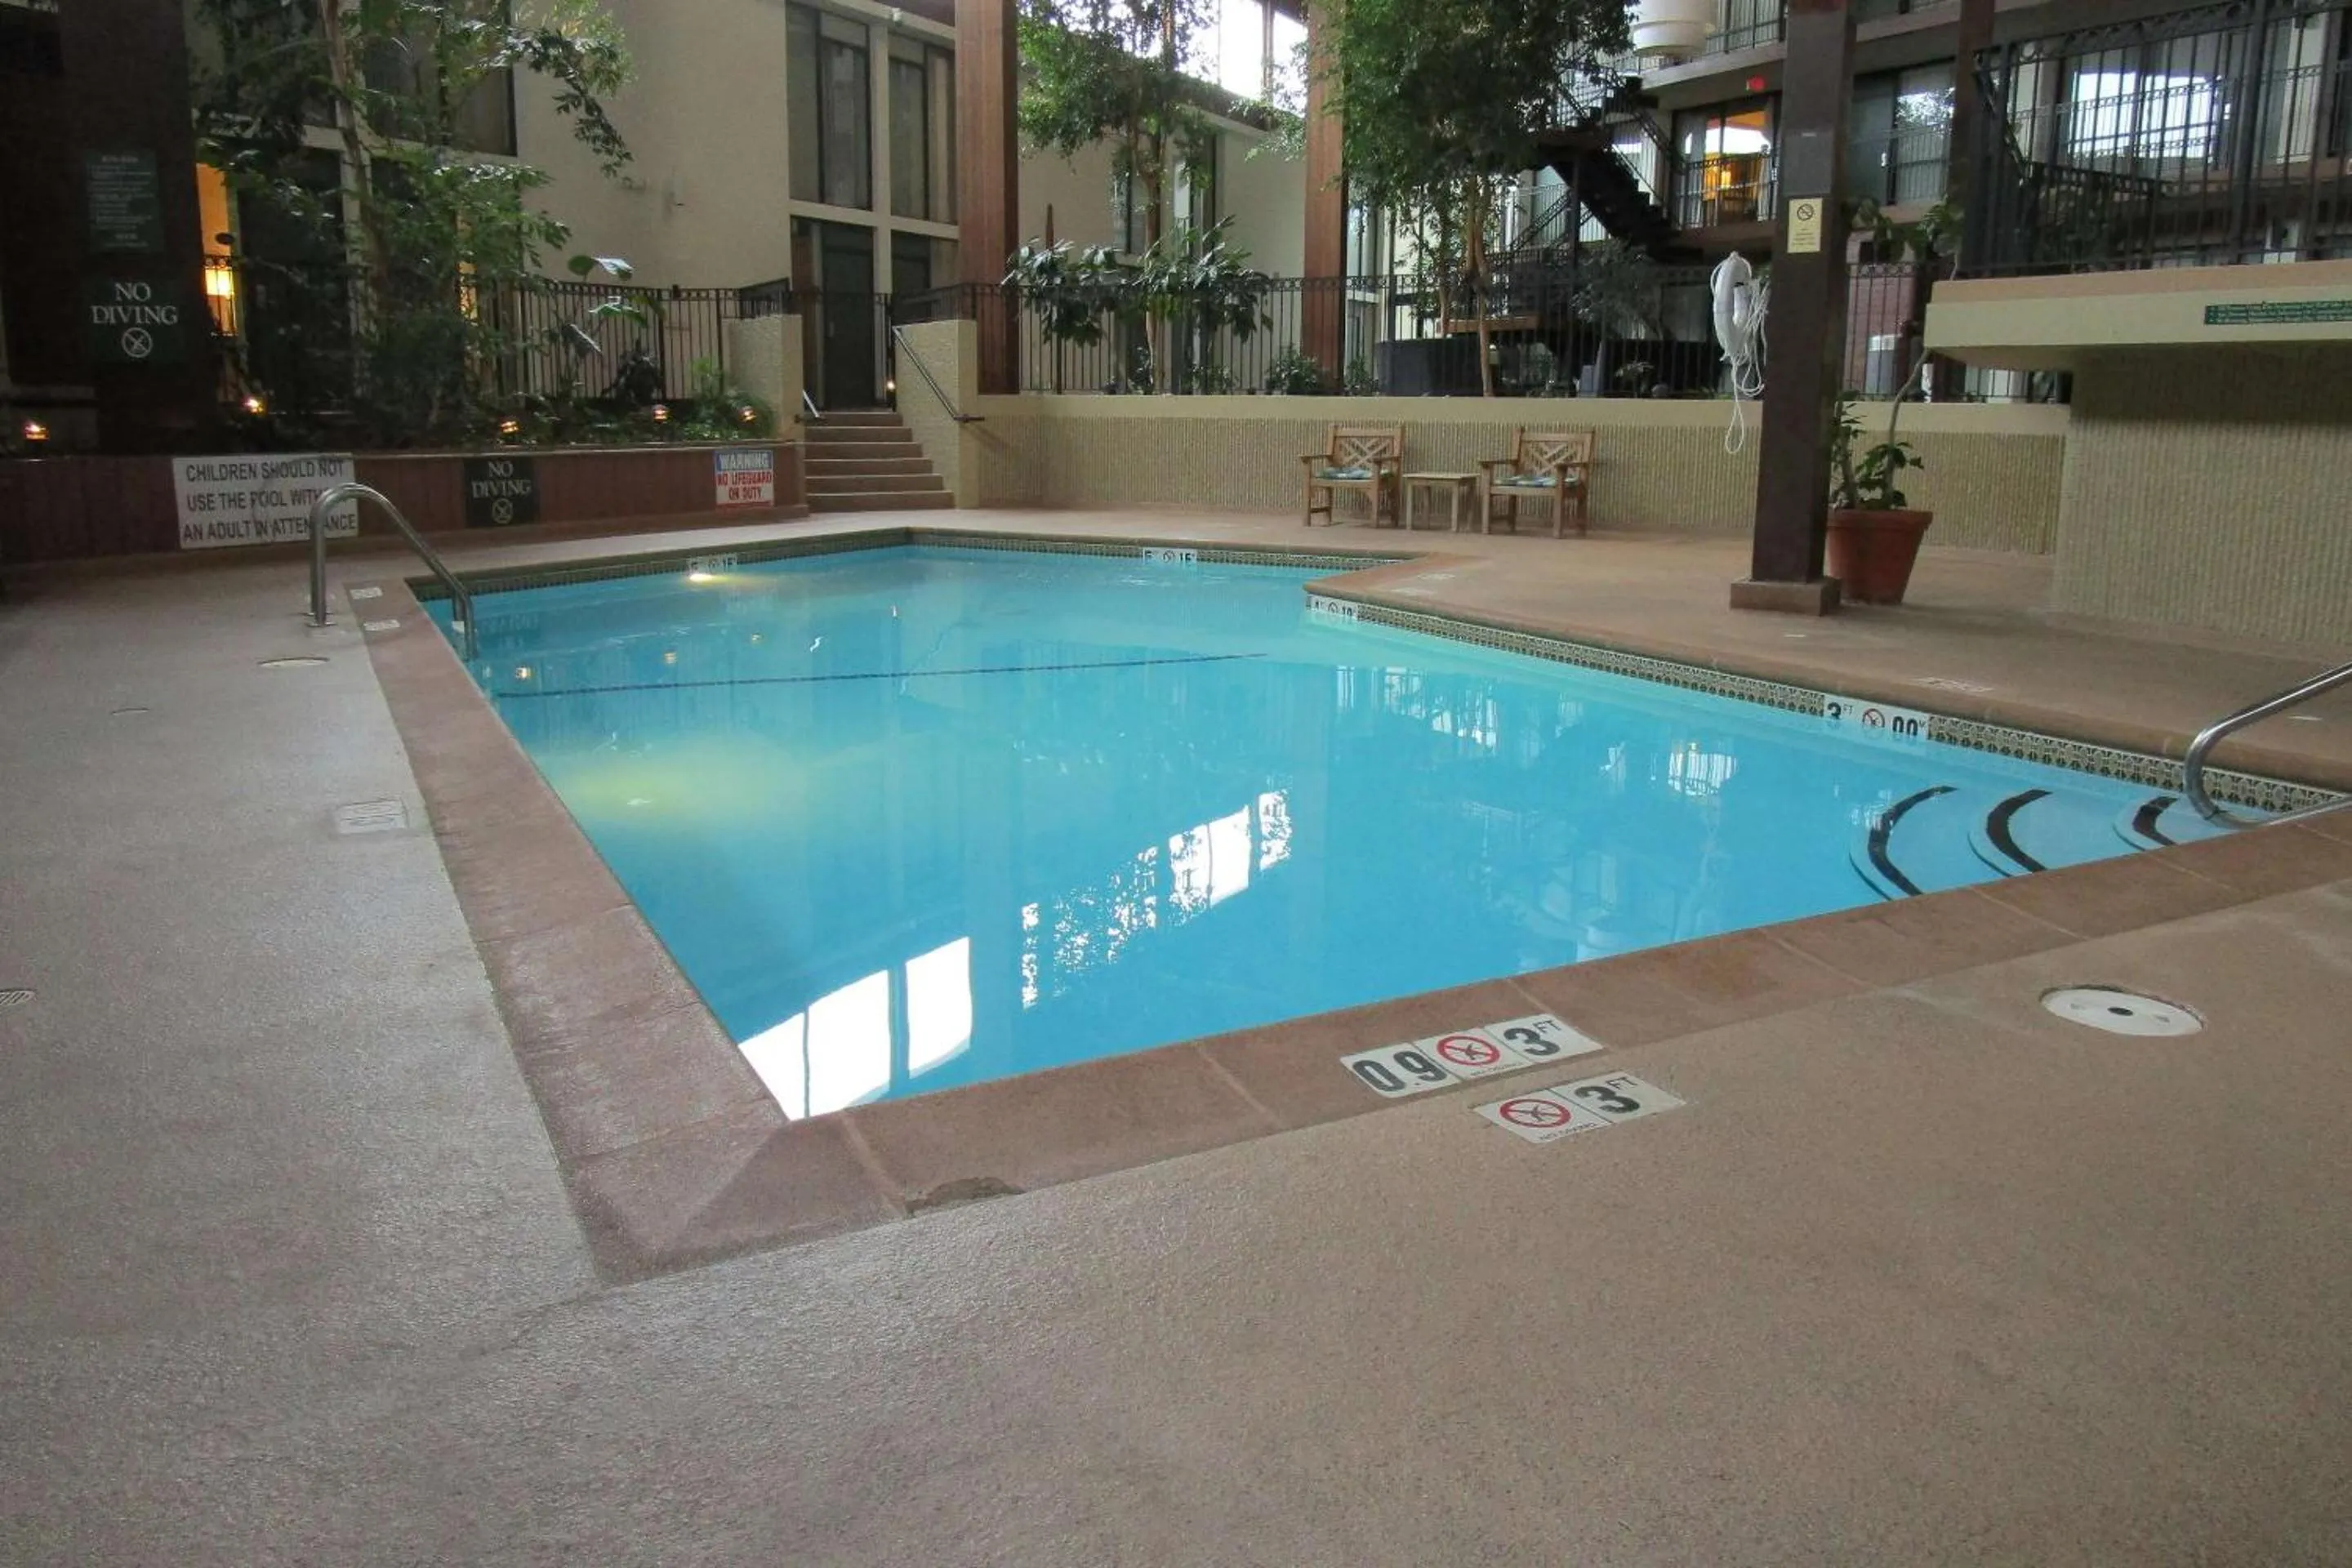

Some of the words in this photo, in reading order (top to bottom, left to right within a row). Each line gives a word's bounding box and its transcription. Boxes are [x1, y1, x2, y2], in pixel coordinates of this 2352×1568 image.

[115, 282, 151, 302] NO
[90, 305, 179, 326] DIVING
[186, 462, 257, 482] CHILDREN
[261, 461, 315, 479] SHOULD
[318, 459, 345, 476] NOT
[488, 460, 514, 478] NO
[719, 452, 769, 470] WARNING
[471, 479, 532, 499] DIVING
[742, 486, 762, 501] DUTY
[187, 493, 216, 512] USE
[220, 492, 250, 510] THE
[251, 489, 288, 509] POOL
[184, 523, 203, 541] AN
[207, 520, 250, 539] ADULT
[252, 519, 269, 537] IN
[273, 513, 356, 535] ATTENANCE
